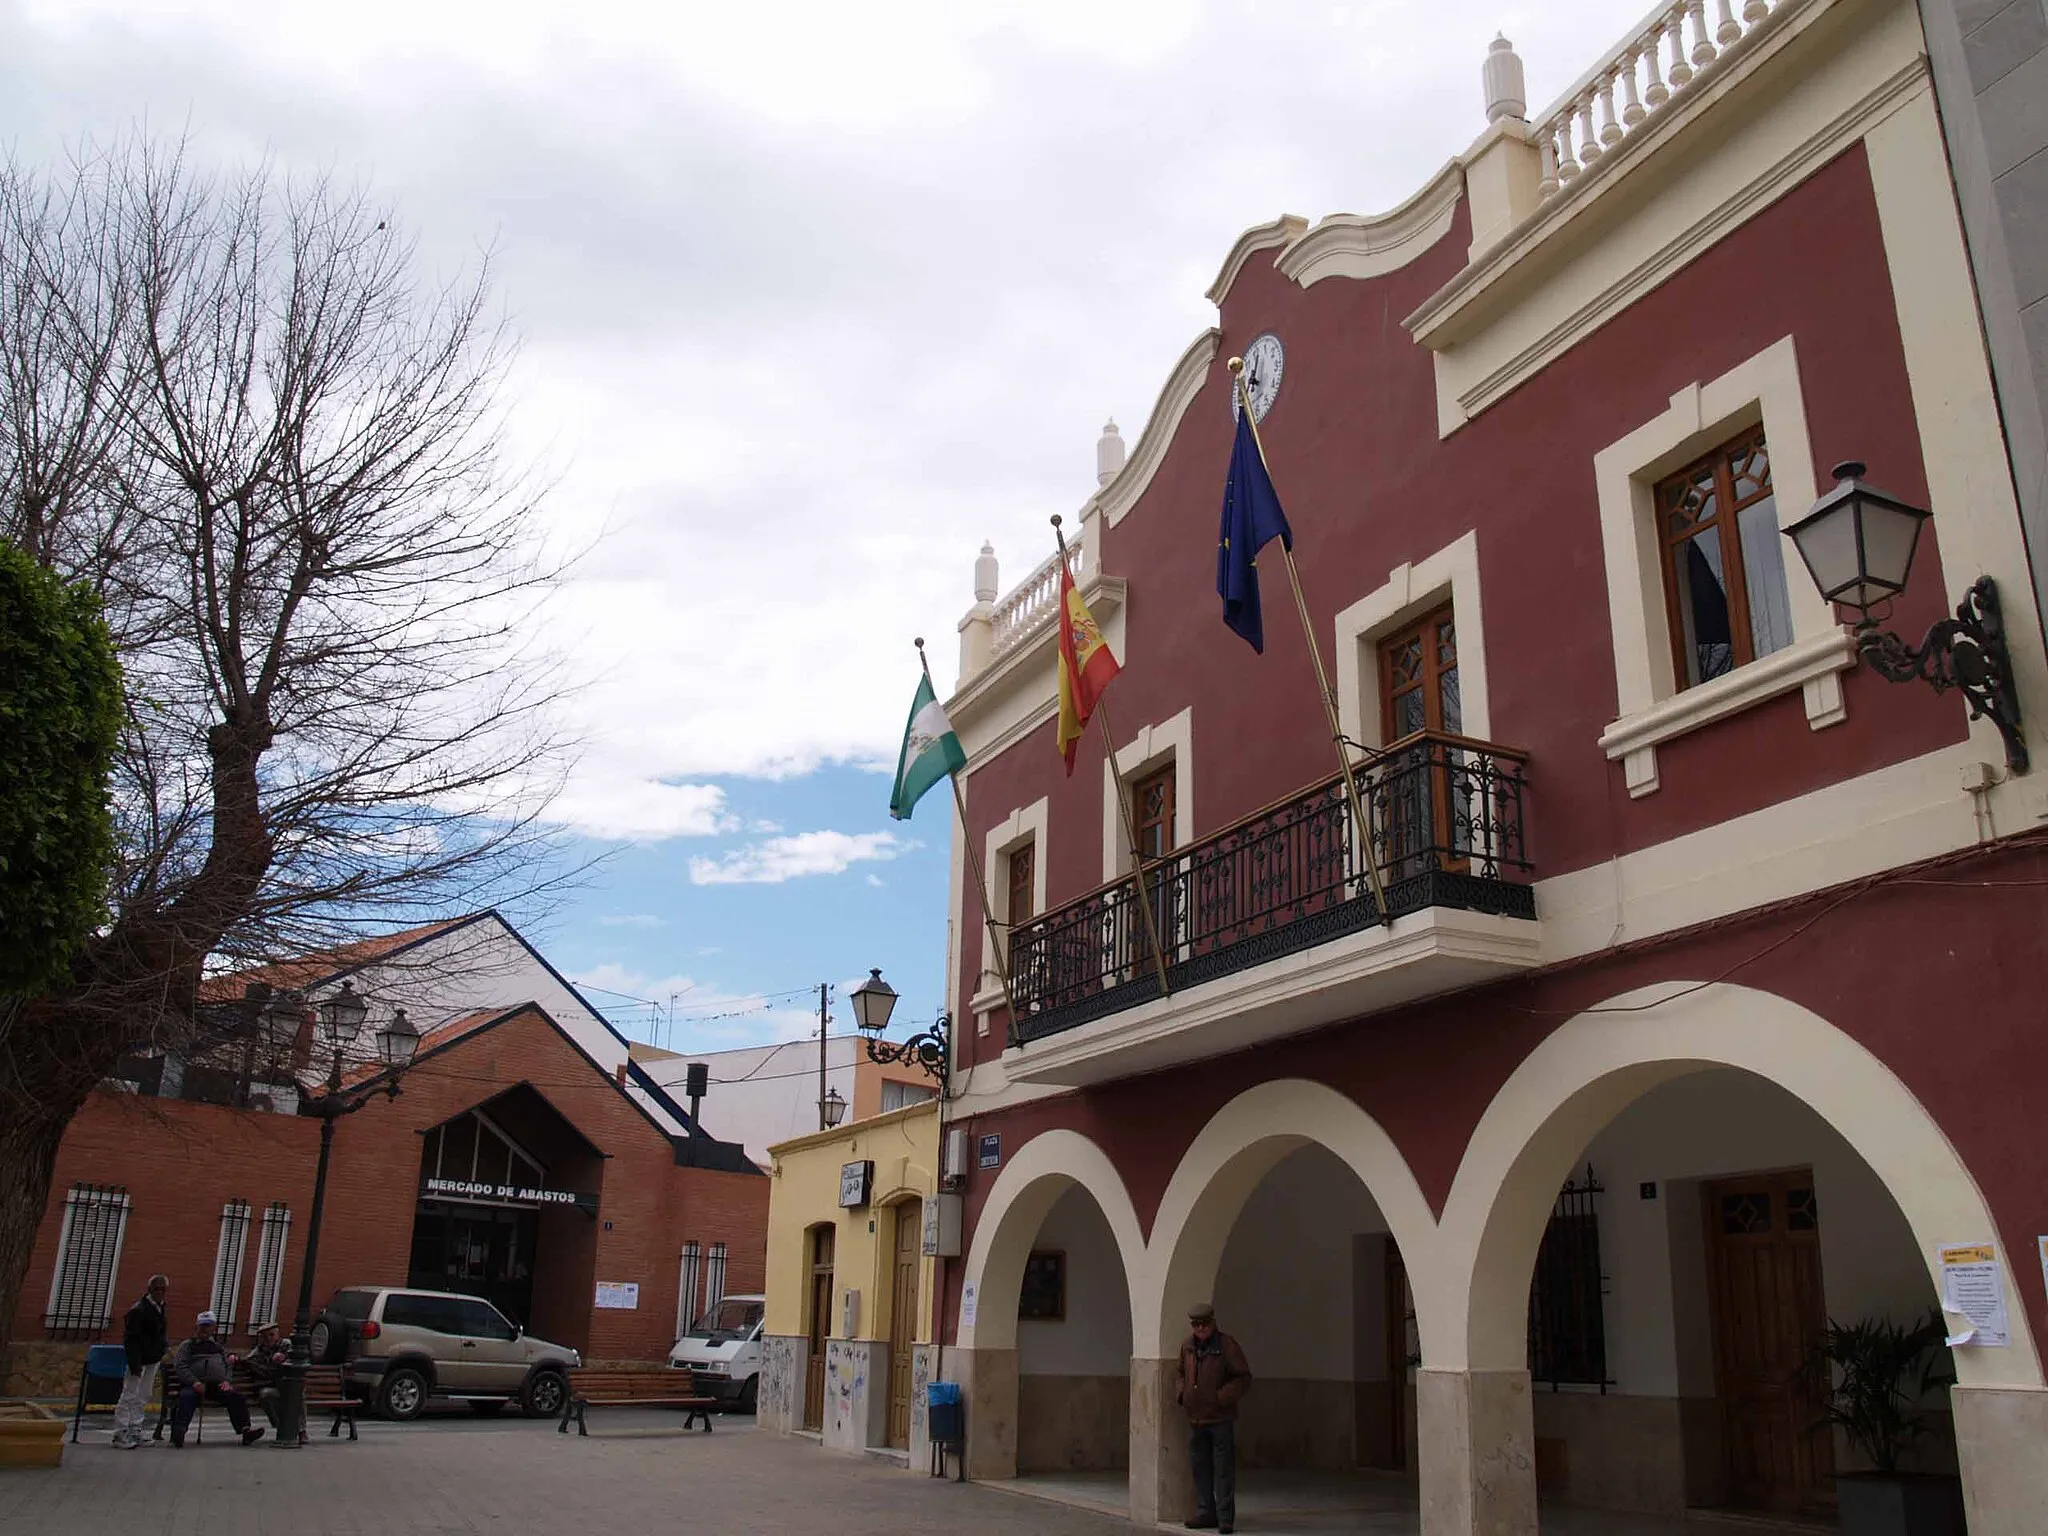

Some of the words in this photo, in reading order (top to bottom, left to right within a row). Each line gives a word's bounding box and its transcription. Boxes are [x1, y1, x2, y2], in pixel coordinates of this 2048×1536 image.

[428, 1179, 492, 1194] MERCADO
[497, 1186, 514, 1197] DE
[519, 1189, 576, 1204] ABASTOS
